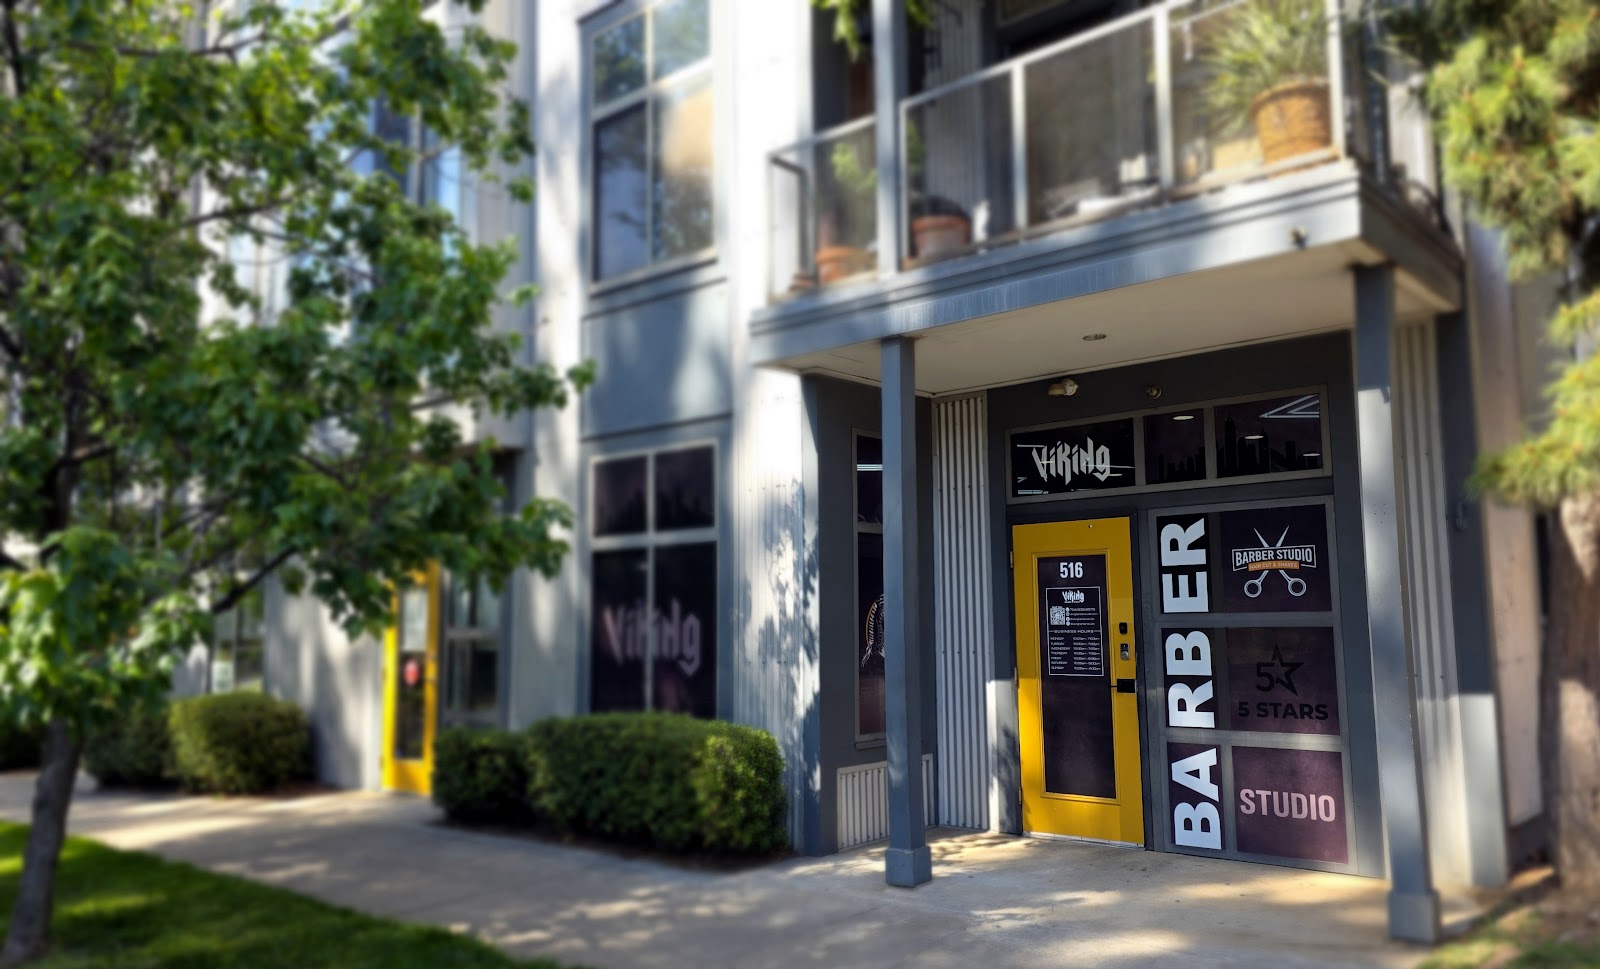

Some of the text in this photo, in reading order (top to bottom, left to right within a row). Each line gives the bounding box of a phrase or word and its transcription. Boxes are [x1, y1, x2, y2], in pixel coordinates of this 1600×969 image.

[1060, 561, 1084, 579] 516
[1235, 548, 1312, 567] BARBER STUDIO
[1160, 517, 1222, 850] BARBER
[1256, 662, 1275, 693] 5
[1238, 701, 1329, 721] 5 STARS
[1240, 788, 1336, 823] STUDIO
